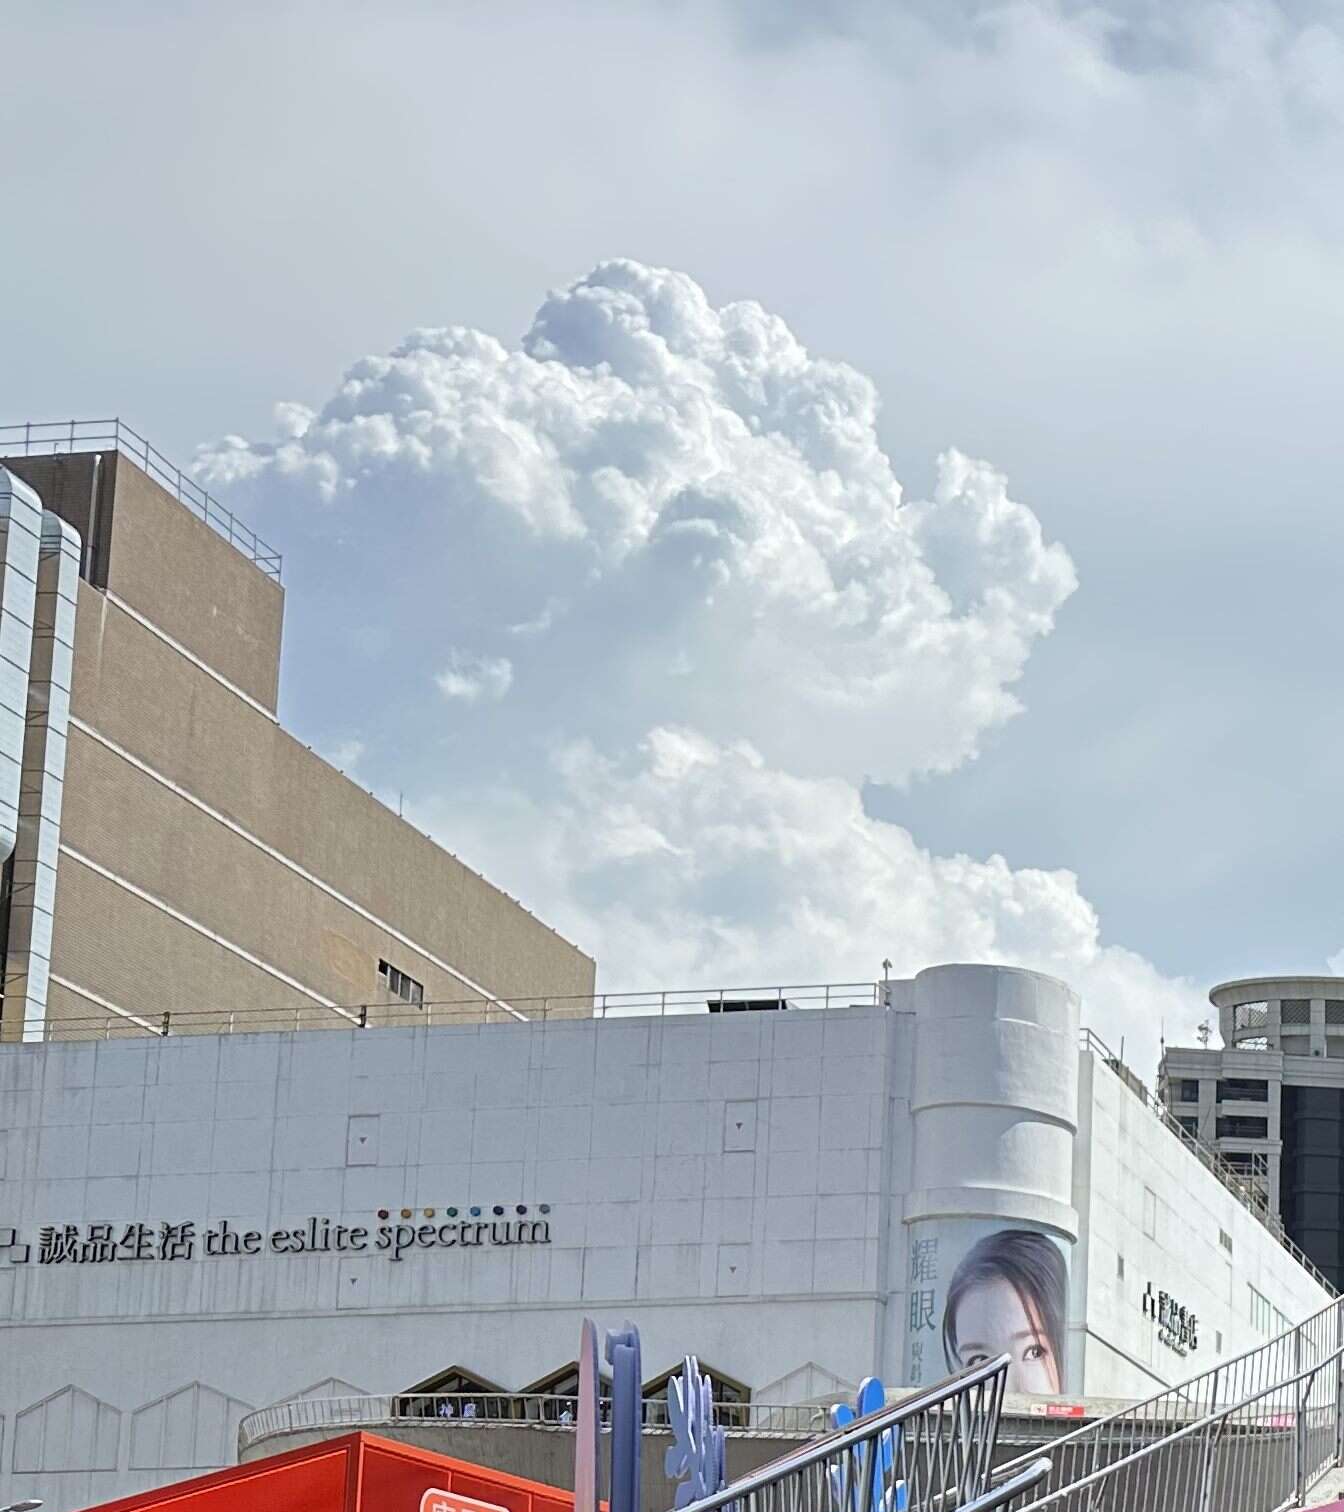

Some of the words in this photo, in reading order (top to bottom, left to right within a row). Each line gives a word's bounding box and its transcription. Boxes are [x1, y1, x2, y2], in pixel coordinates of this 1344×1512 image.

[38, 1221, 195, 1264] 誠品生活
[203, 1220, 262, 1255] the
[271, 1217, 368, 1252] eslite
[376, 1220, 551, 1261] spectrum
[910, 1238, 938, 1332] 耀眼
